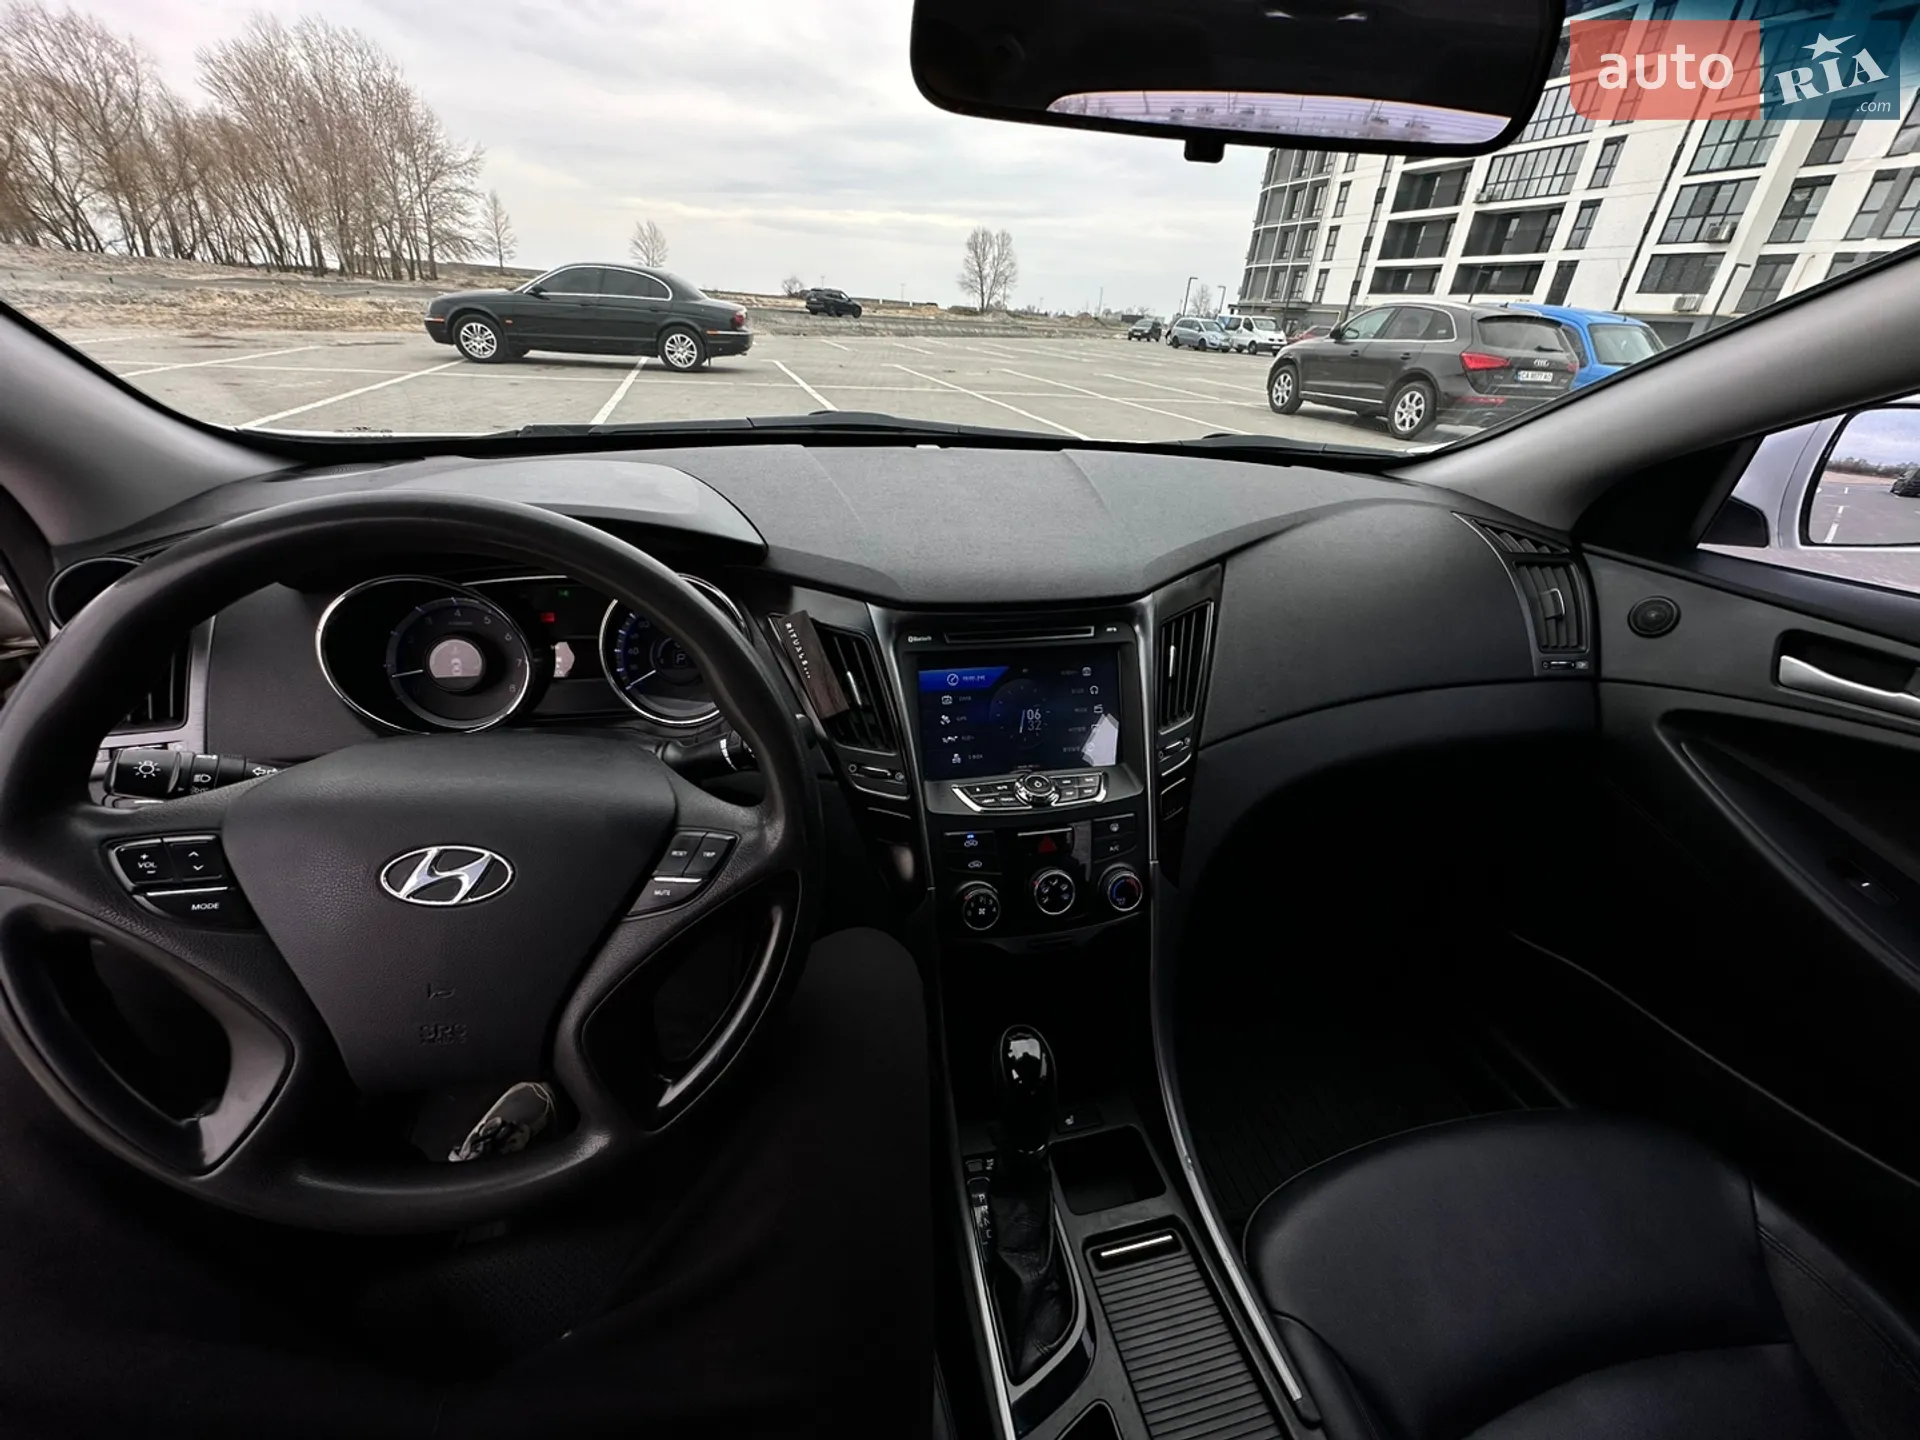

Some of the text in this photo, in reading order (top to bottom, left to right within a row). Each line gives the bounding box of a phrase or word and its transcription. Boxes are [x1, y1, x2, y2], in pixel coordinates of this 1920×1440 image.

[453, 609, 462, 618] 4
[483, 616, 492, 625] 5
[504, 633, 513, 642] 6
[509, 684, 517, 693] 8
[1026, 708, 1042, 721] 06
[1027, 720, 1042, 731] 32
[137, 861, 158, 869] VOL
[190, 901, 221, 911] MODE
